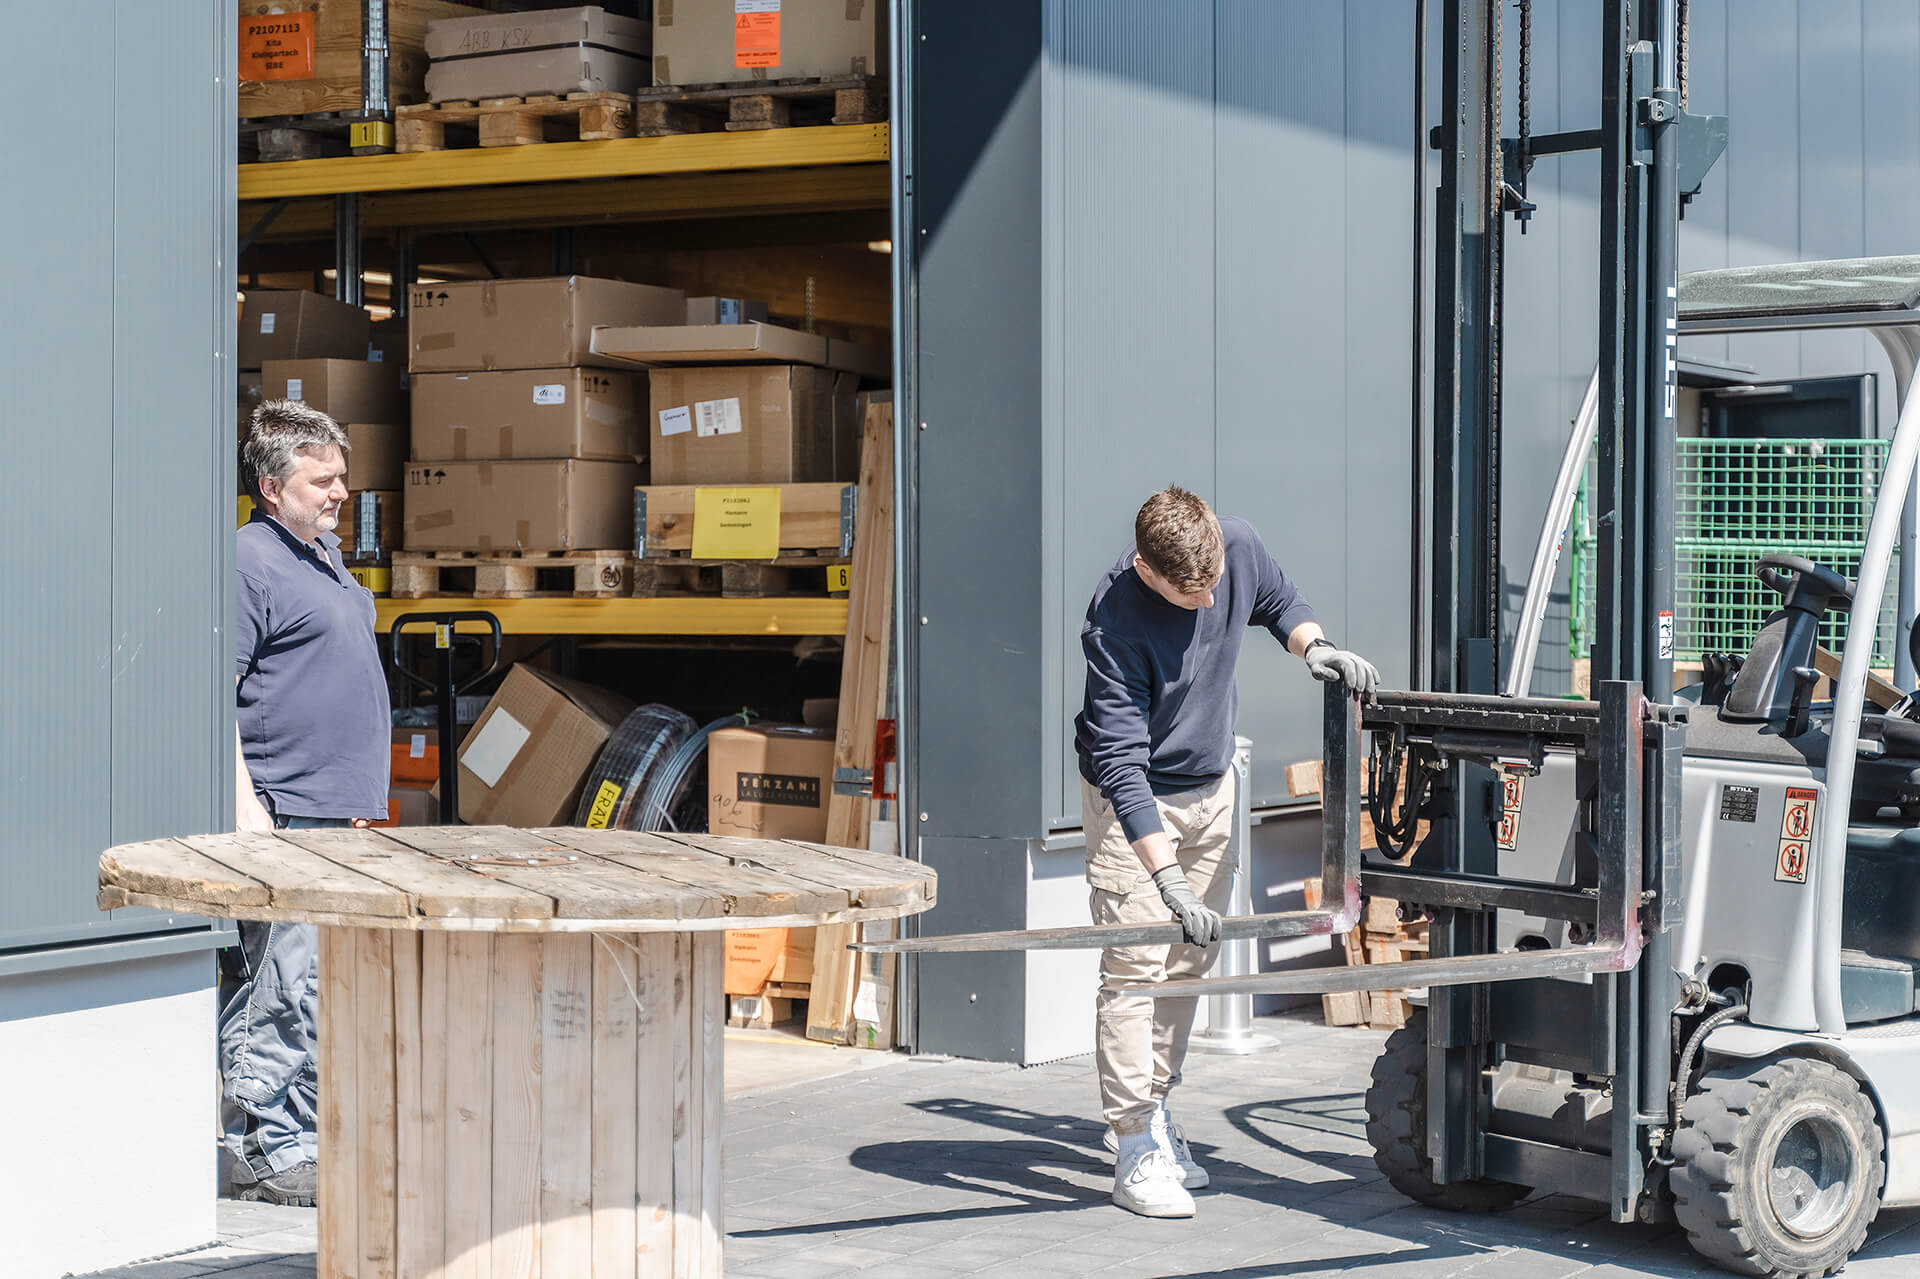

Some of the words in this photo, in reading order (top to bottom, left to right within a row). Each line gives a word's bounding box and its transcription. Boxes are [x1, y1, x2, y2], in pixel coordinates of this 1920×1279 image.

[249, 24, 301, 35] P2107113
[459, 29, 490, 51] ABB
[363, 125, 368, 142] 1
[840, 568, 847, 587] 6
[741, 777, 817, 792] TERZANI
[1797, 791, 1816, 799] DANGER
